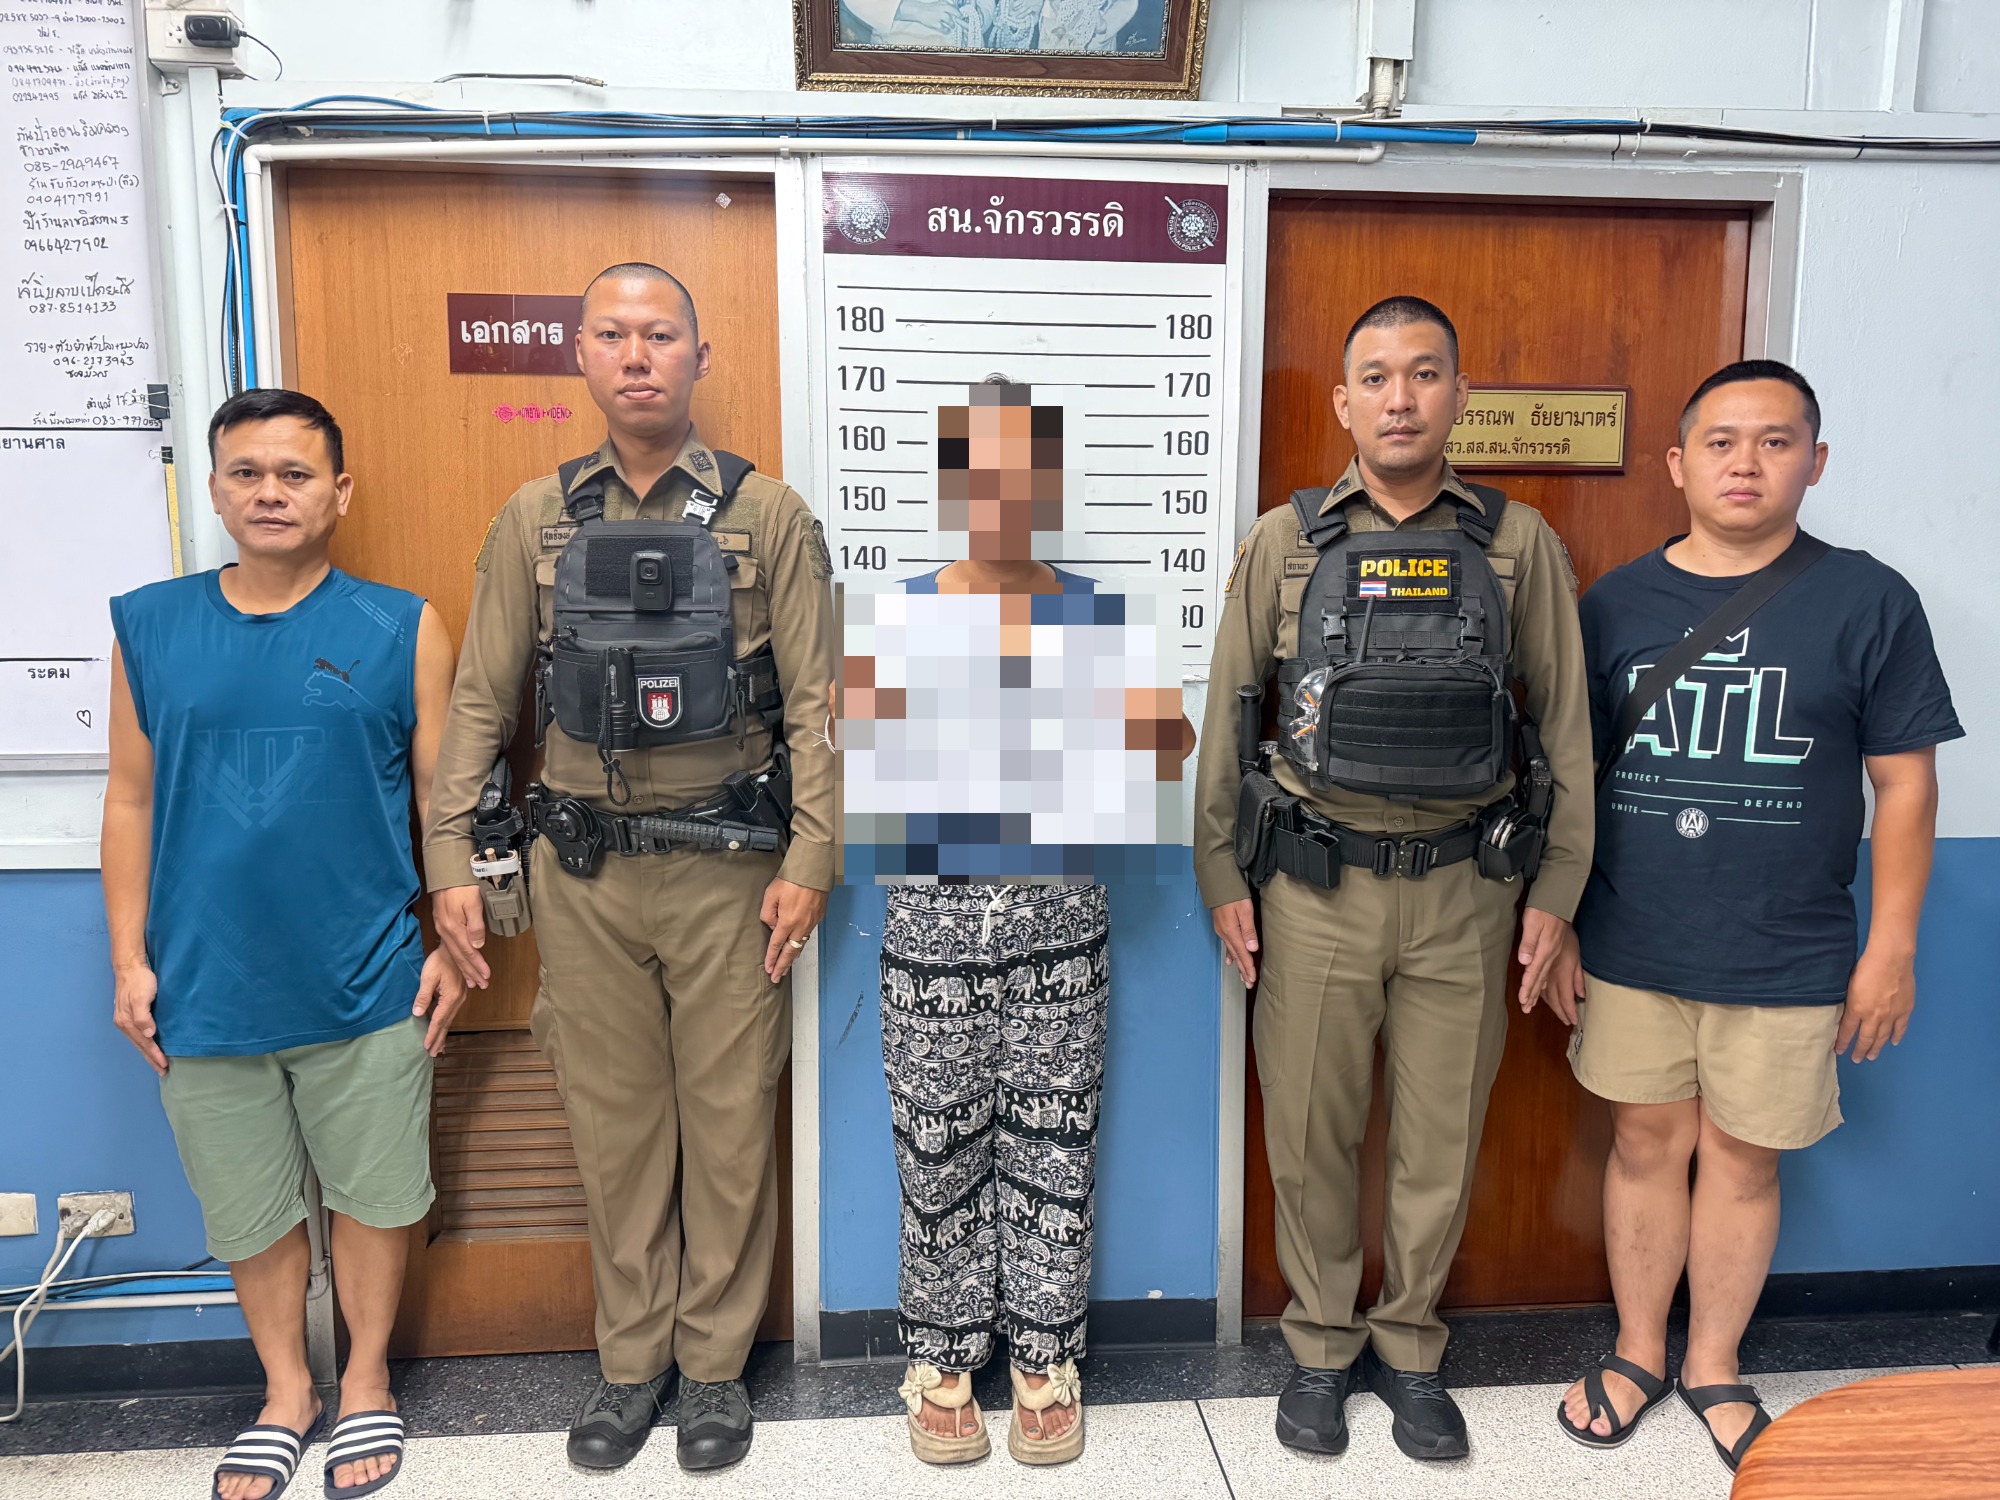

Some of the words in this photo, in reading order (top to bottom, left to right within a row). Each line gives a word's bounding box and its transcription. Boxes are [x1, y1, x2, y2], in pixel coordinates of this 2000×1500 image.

[927, 196, 1125, 237] สน.จักรวรรดิ
[461, 319, 564, 345] เอกสาร
[837, 306, 885, 332] 180
[1166, 314, 1213, 340] 180
[838, 366, 885, 392] 170
[1164, 372, 1211, 397] 170
[1531, 403, 1618, 427] ธัยยามาตร์
[0, 438, 66, 449] ยานศาล
[838, 425, 886, 451] 160
[1163, 431, 1210, 456] 160
[840, 486, 886, 511] 150
[1162, 490, 1208, 515] 150
[840, 545, 887, 570] 140
[1160, 548, 1206, 572] 140
[1360, 559, 1449, 578] POLICE
[1390, 587, 1449, 597] THAILAND
[27, 667, 70, 679] ระดม
[640, 680, 678, 689] POLIZEI
[1615, 770, 1660, 783] PROTECT
[1611, 802, 1638, 814] UNITE
[1744, 799, 1803, 809] DEFEND
